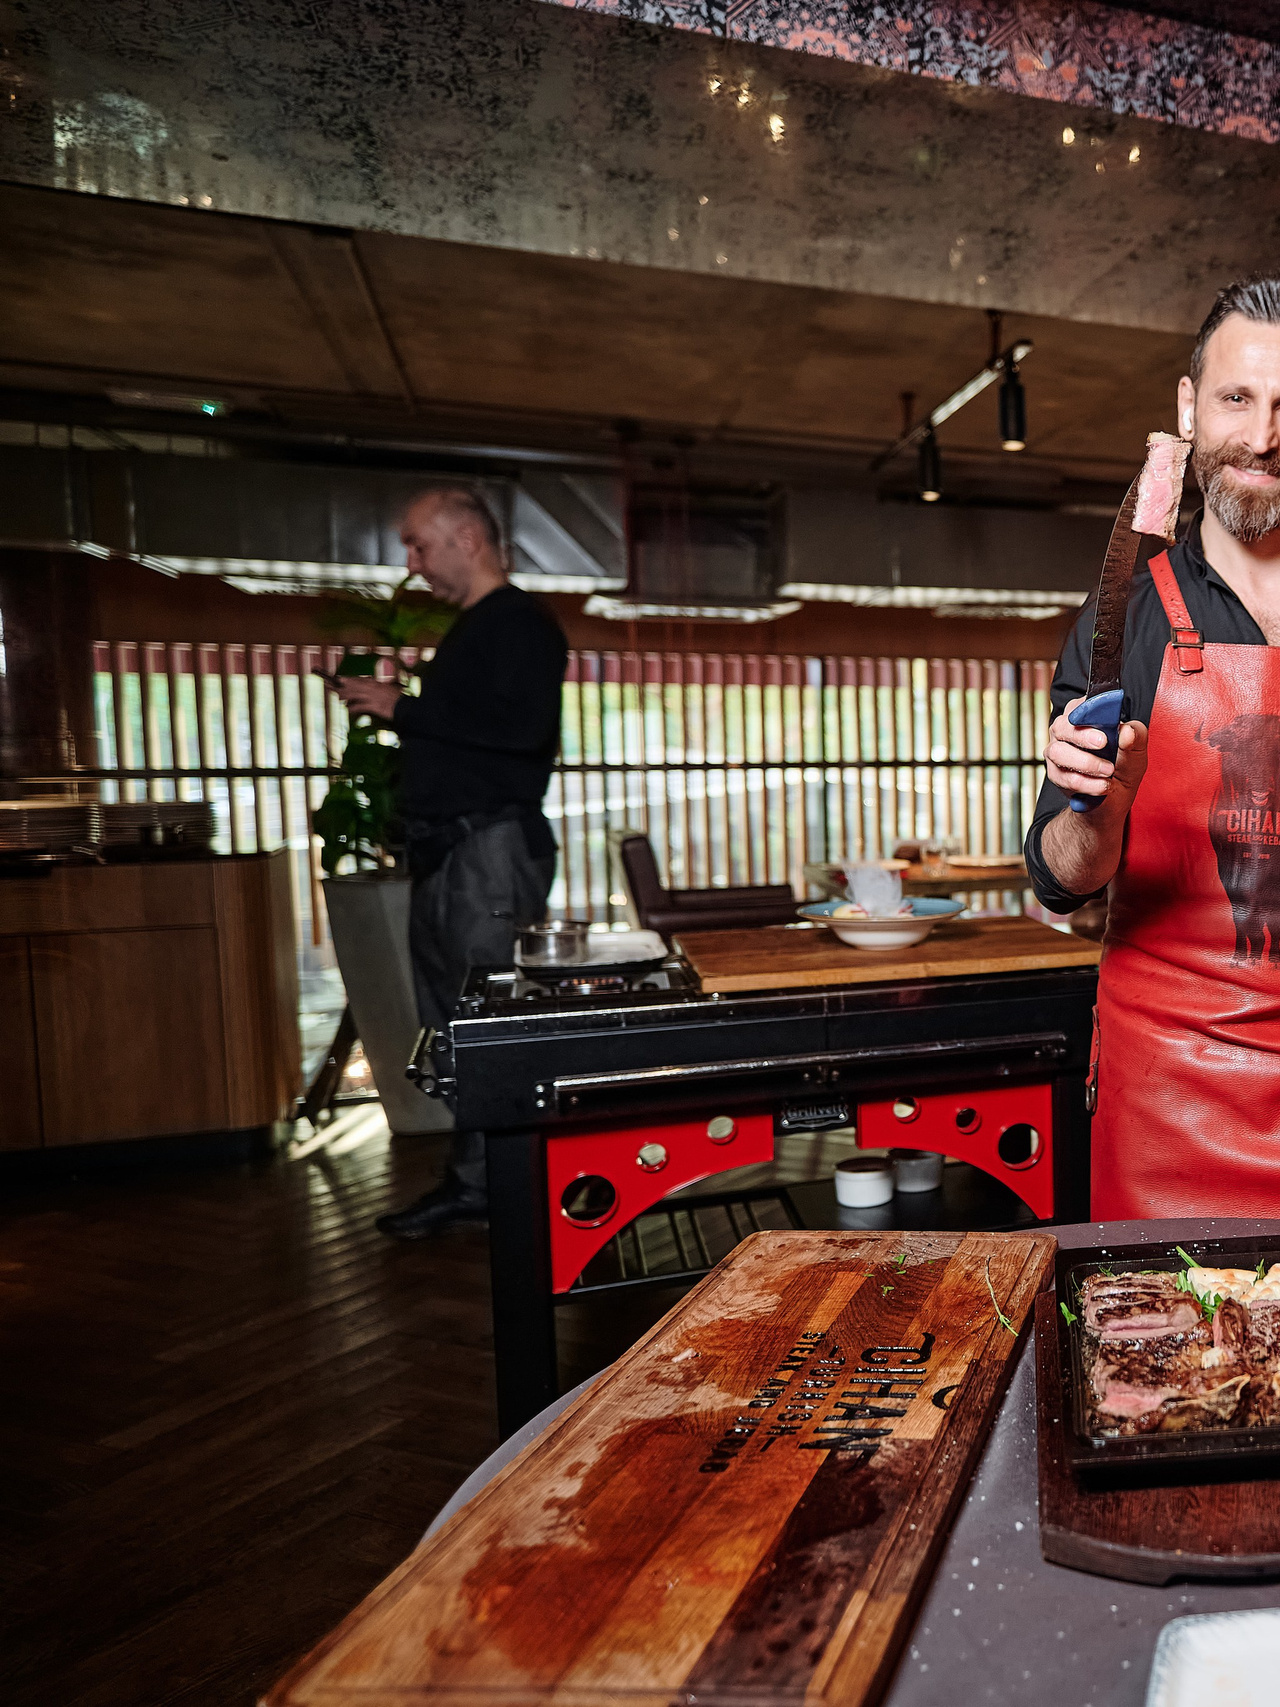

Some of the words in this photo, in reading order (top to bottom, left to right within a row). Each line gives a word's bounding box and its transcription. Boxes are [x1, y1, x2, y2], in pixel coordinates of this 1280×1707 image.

[1227, 833, 1251, 844] STEAK
[774, 1331, 827, 1373] STEAK
[747, 1377, 791, 1409] AND
[799, 1332, 936, 1469] CIHAN
